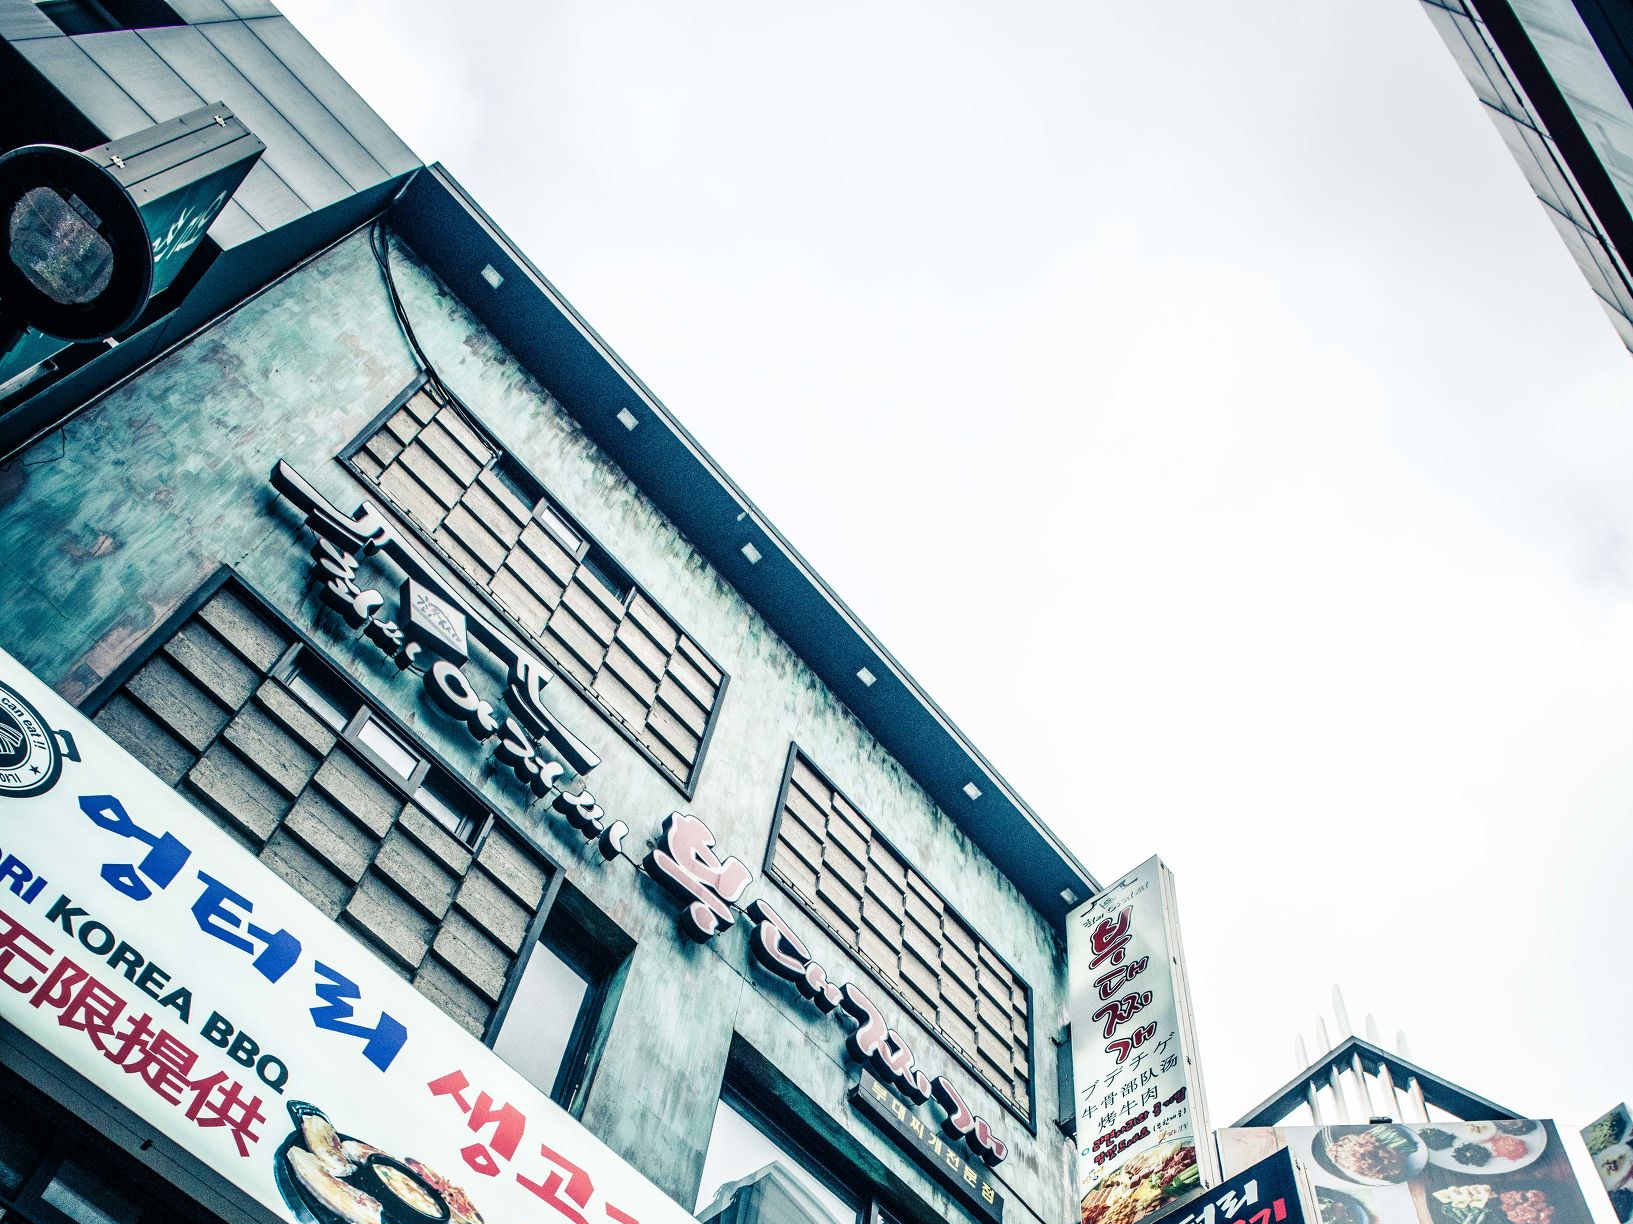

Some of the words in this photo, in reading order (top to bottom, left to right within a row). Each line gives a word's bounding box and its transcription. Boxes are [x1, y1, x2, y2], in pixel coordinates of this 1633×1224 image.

[2, 697, 25, 717] can
[0, 848, 48, 905] RI
[45, 894, 192, 1024] KOREA
[200, 1011, 289, 1095] BBQ
[0, 910, 267, 1158] 无限提供
